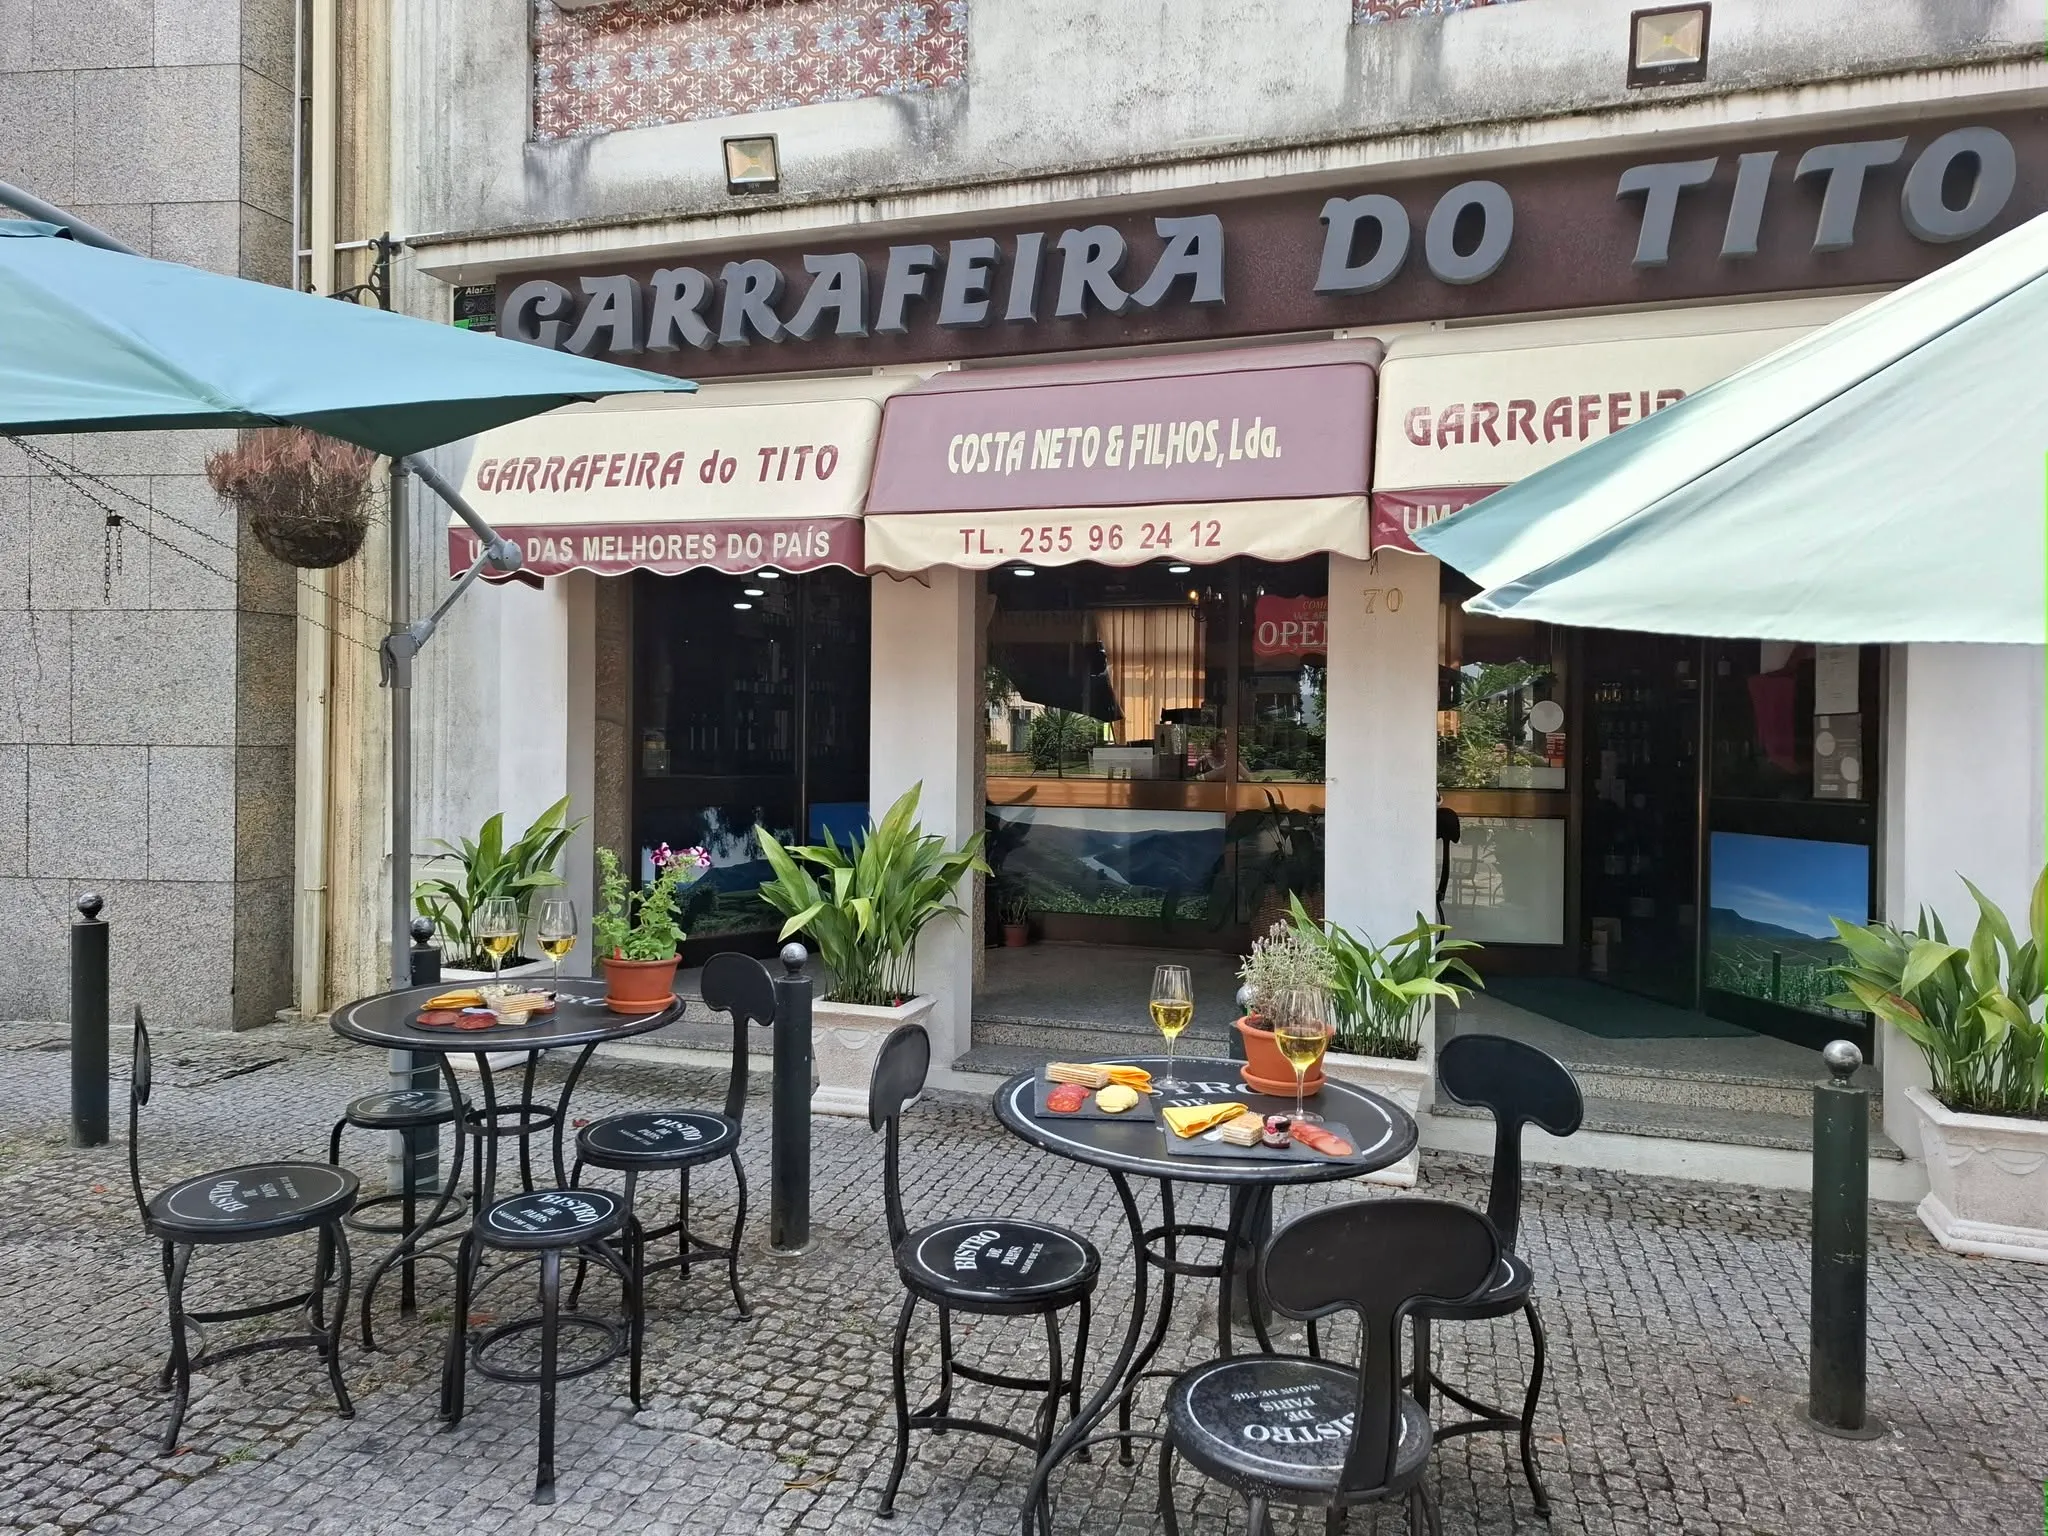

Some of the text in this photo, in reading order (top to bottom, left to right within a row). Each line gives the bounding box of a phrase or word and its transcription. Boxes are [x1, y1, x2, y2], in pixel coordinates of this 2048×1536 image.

[501, 127, 2017, 356] GARRAFEIRA DO TITO
[948, 417, 1282, 476] COSTA NETO & FILHOS, Lda.
[477, 445, 839, 495] GARRAFEIRA do TITO
[1403, 504, 1469, 535] UM
[527, 537, 573, 562] DAS
[583, 534, 717, 561] MELHORES
[727, 533, 763, 559] DO
[773, 525, 830, 558] PAÍS
[960, 520, 1222, 554] TL. 255 96 24 12
[1363, 588, 1404, 614] 70
[537, 1194, 600, 1222] BISTRO
[954, 1230, 1001, 1272] BISTRO
[1259, 1396, 1317, 1412] PARIS
[1281, 1384, 1321, 1394] SALON
[1285, 1408, 1315, 1422] DE
